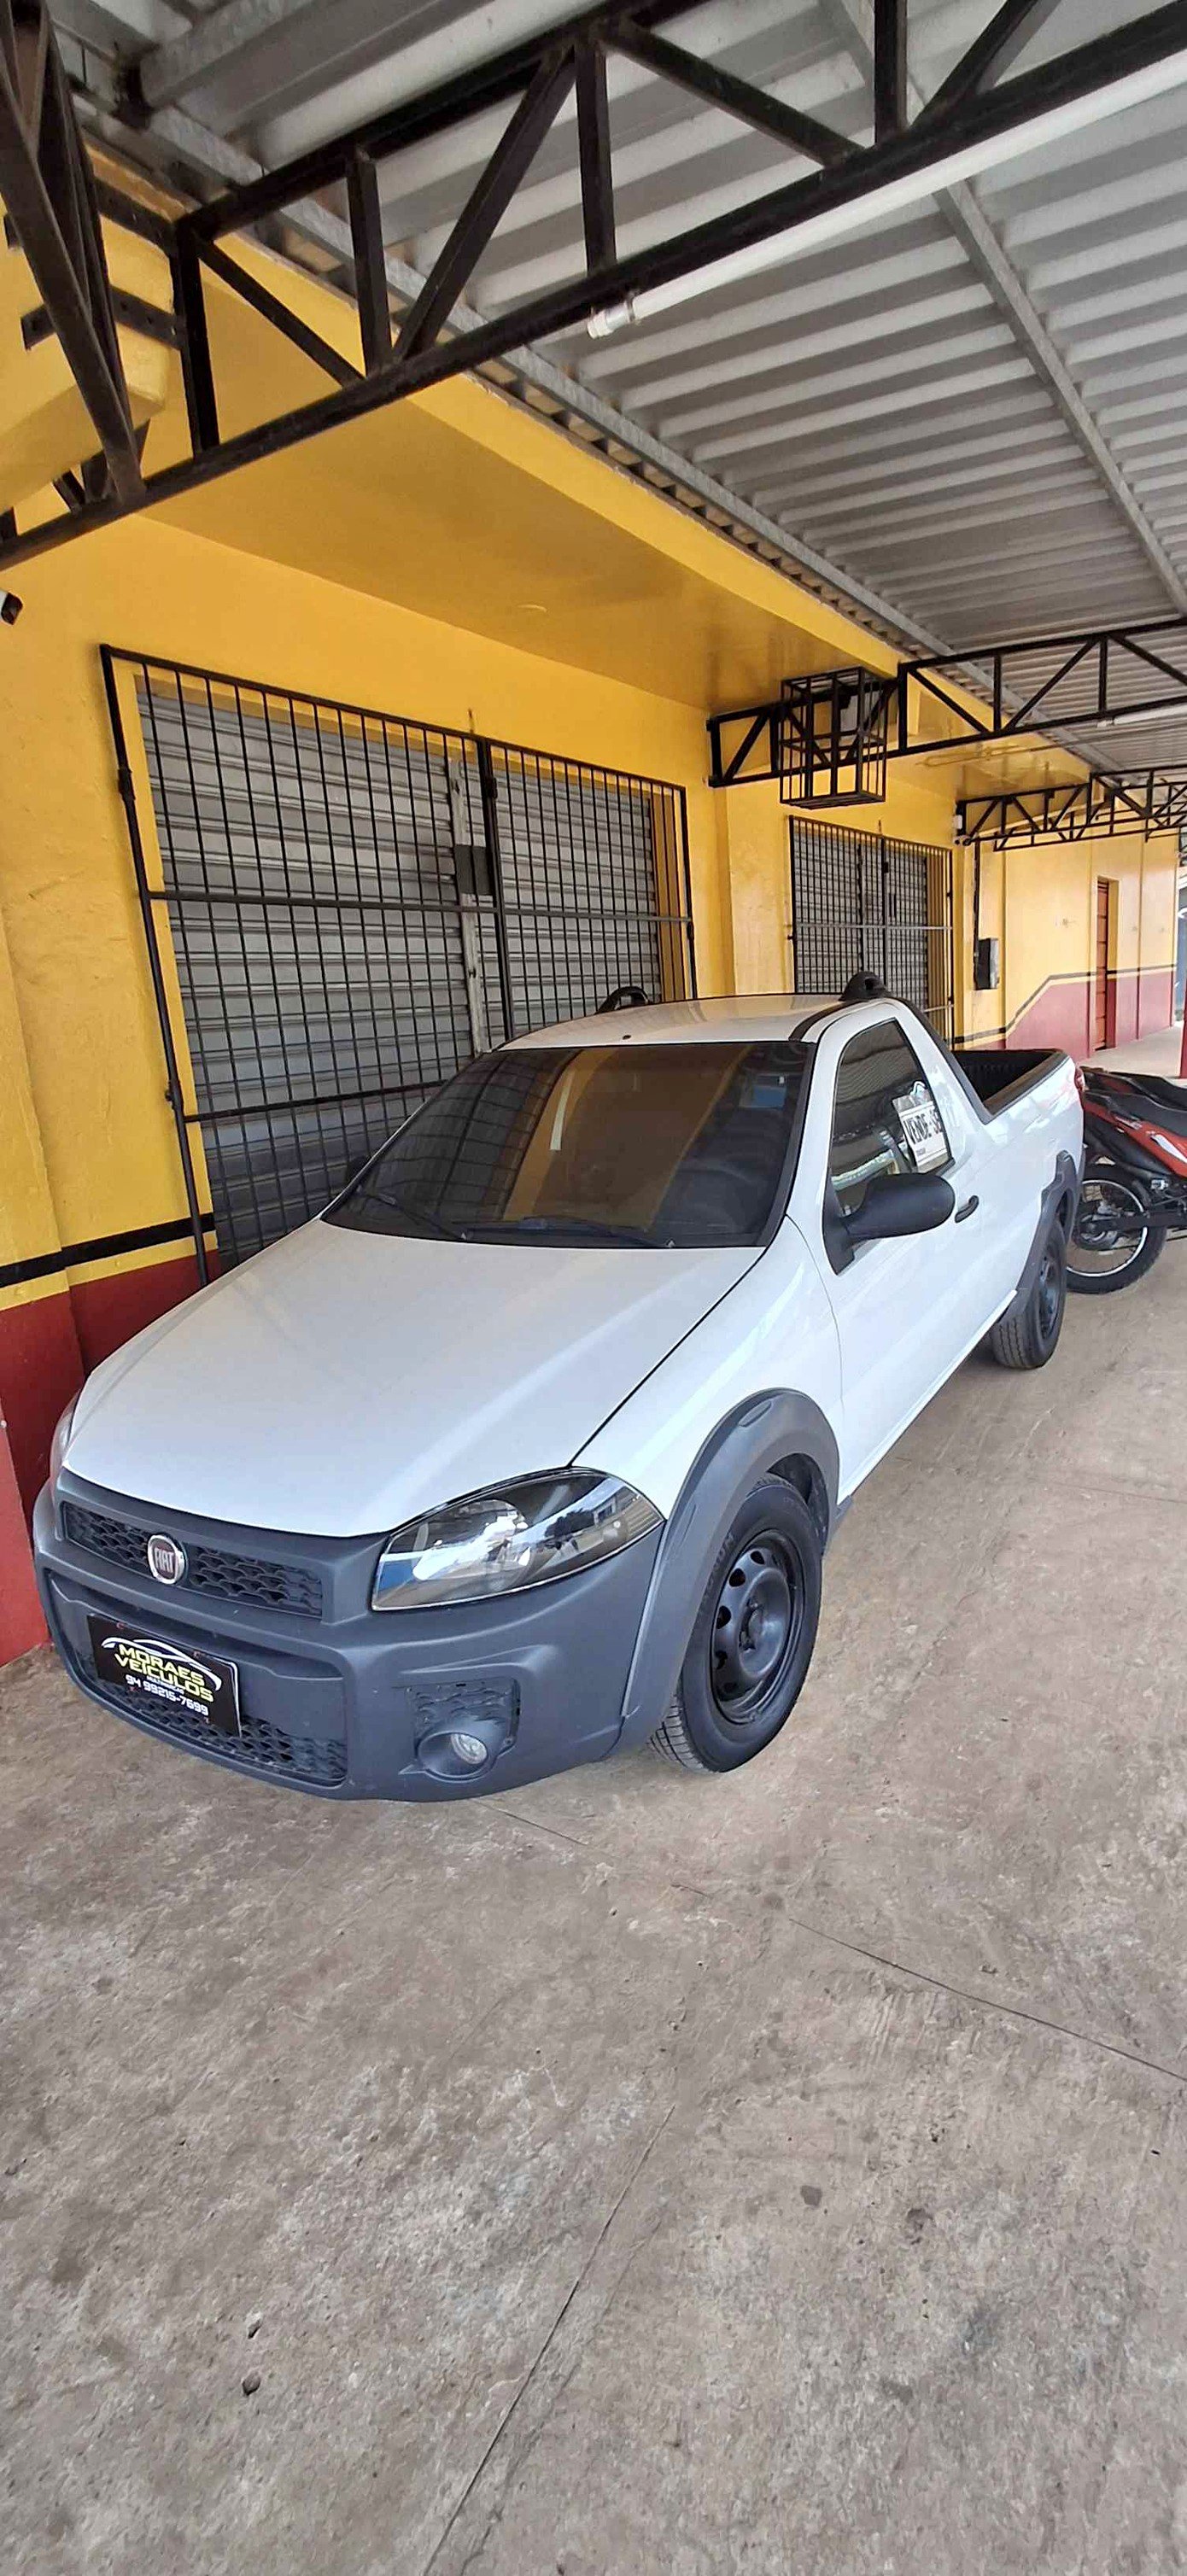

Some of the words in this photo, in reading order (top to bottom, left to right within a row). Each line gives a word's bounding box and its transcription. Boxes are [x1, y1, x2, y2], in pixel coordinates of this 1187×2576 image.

[155, 1547, 174, 1574] FIAT
[118, 1644, 205, 1687] MORAES
[126, 1674, 141, 1688] 94
[143, 1680, 209, 1716] 99215-7699
